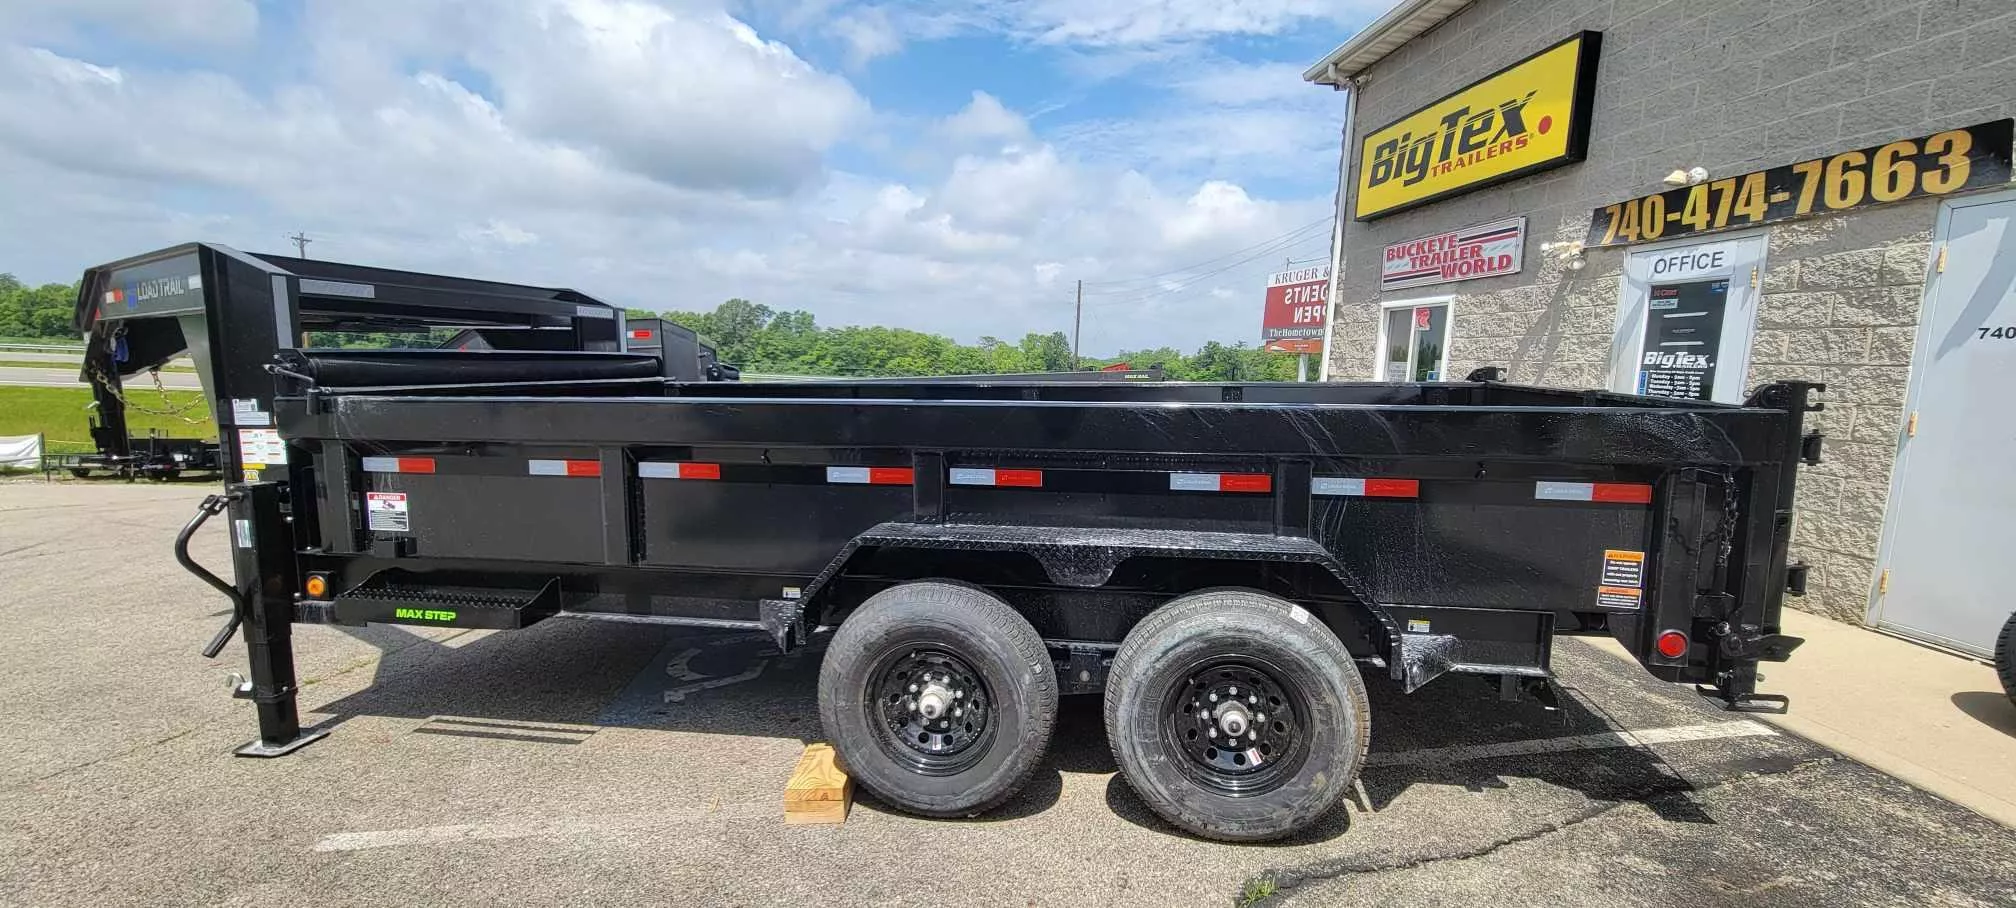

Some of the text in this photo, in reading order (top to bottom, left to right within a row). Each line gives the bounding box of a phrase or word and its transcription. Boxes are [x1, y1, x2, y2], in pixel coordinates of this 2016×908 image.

[1431, 133, 1529, 177] TRAILERS
[1601, 129, 1973, 244] 740-474-7663
[1386, 233, 1459, 262] BUCKEYE
[1409, 243, 1484, 269] TRAILER
[1440, 254, 1514, 280] WORLD
[1654, 250, 1725, 274] OFFICE
[1275, 267, 1318, 284] KRUGER
[137, 277, 185, 300] LOAD TRAIL
[1978, 326, 2016, 340] 740
[396, 608, 456, 621] MAX STEP
